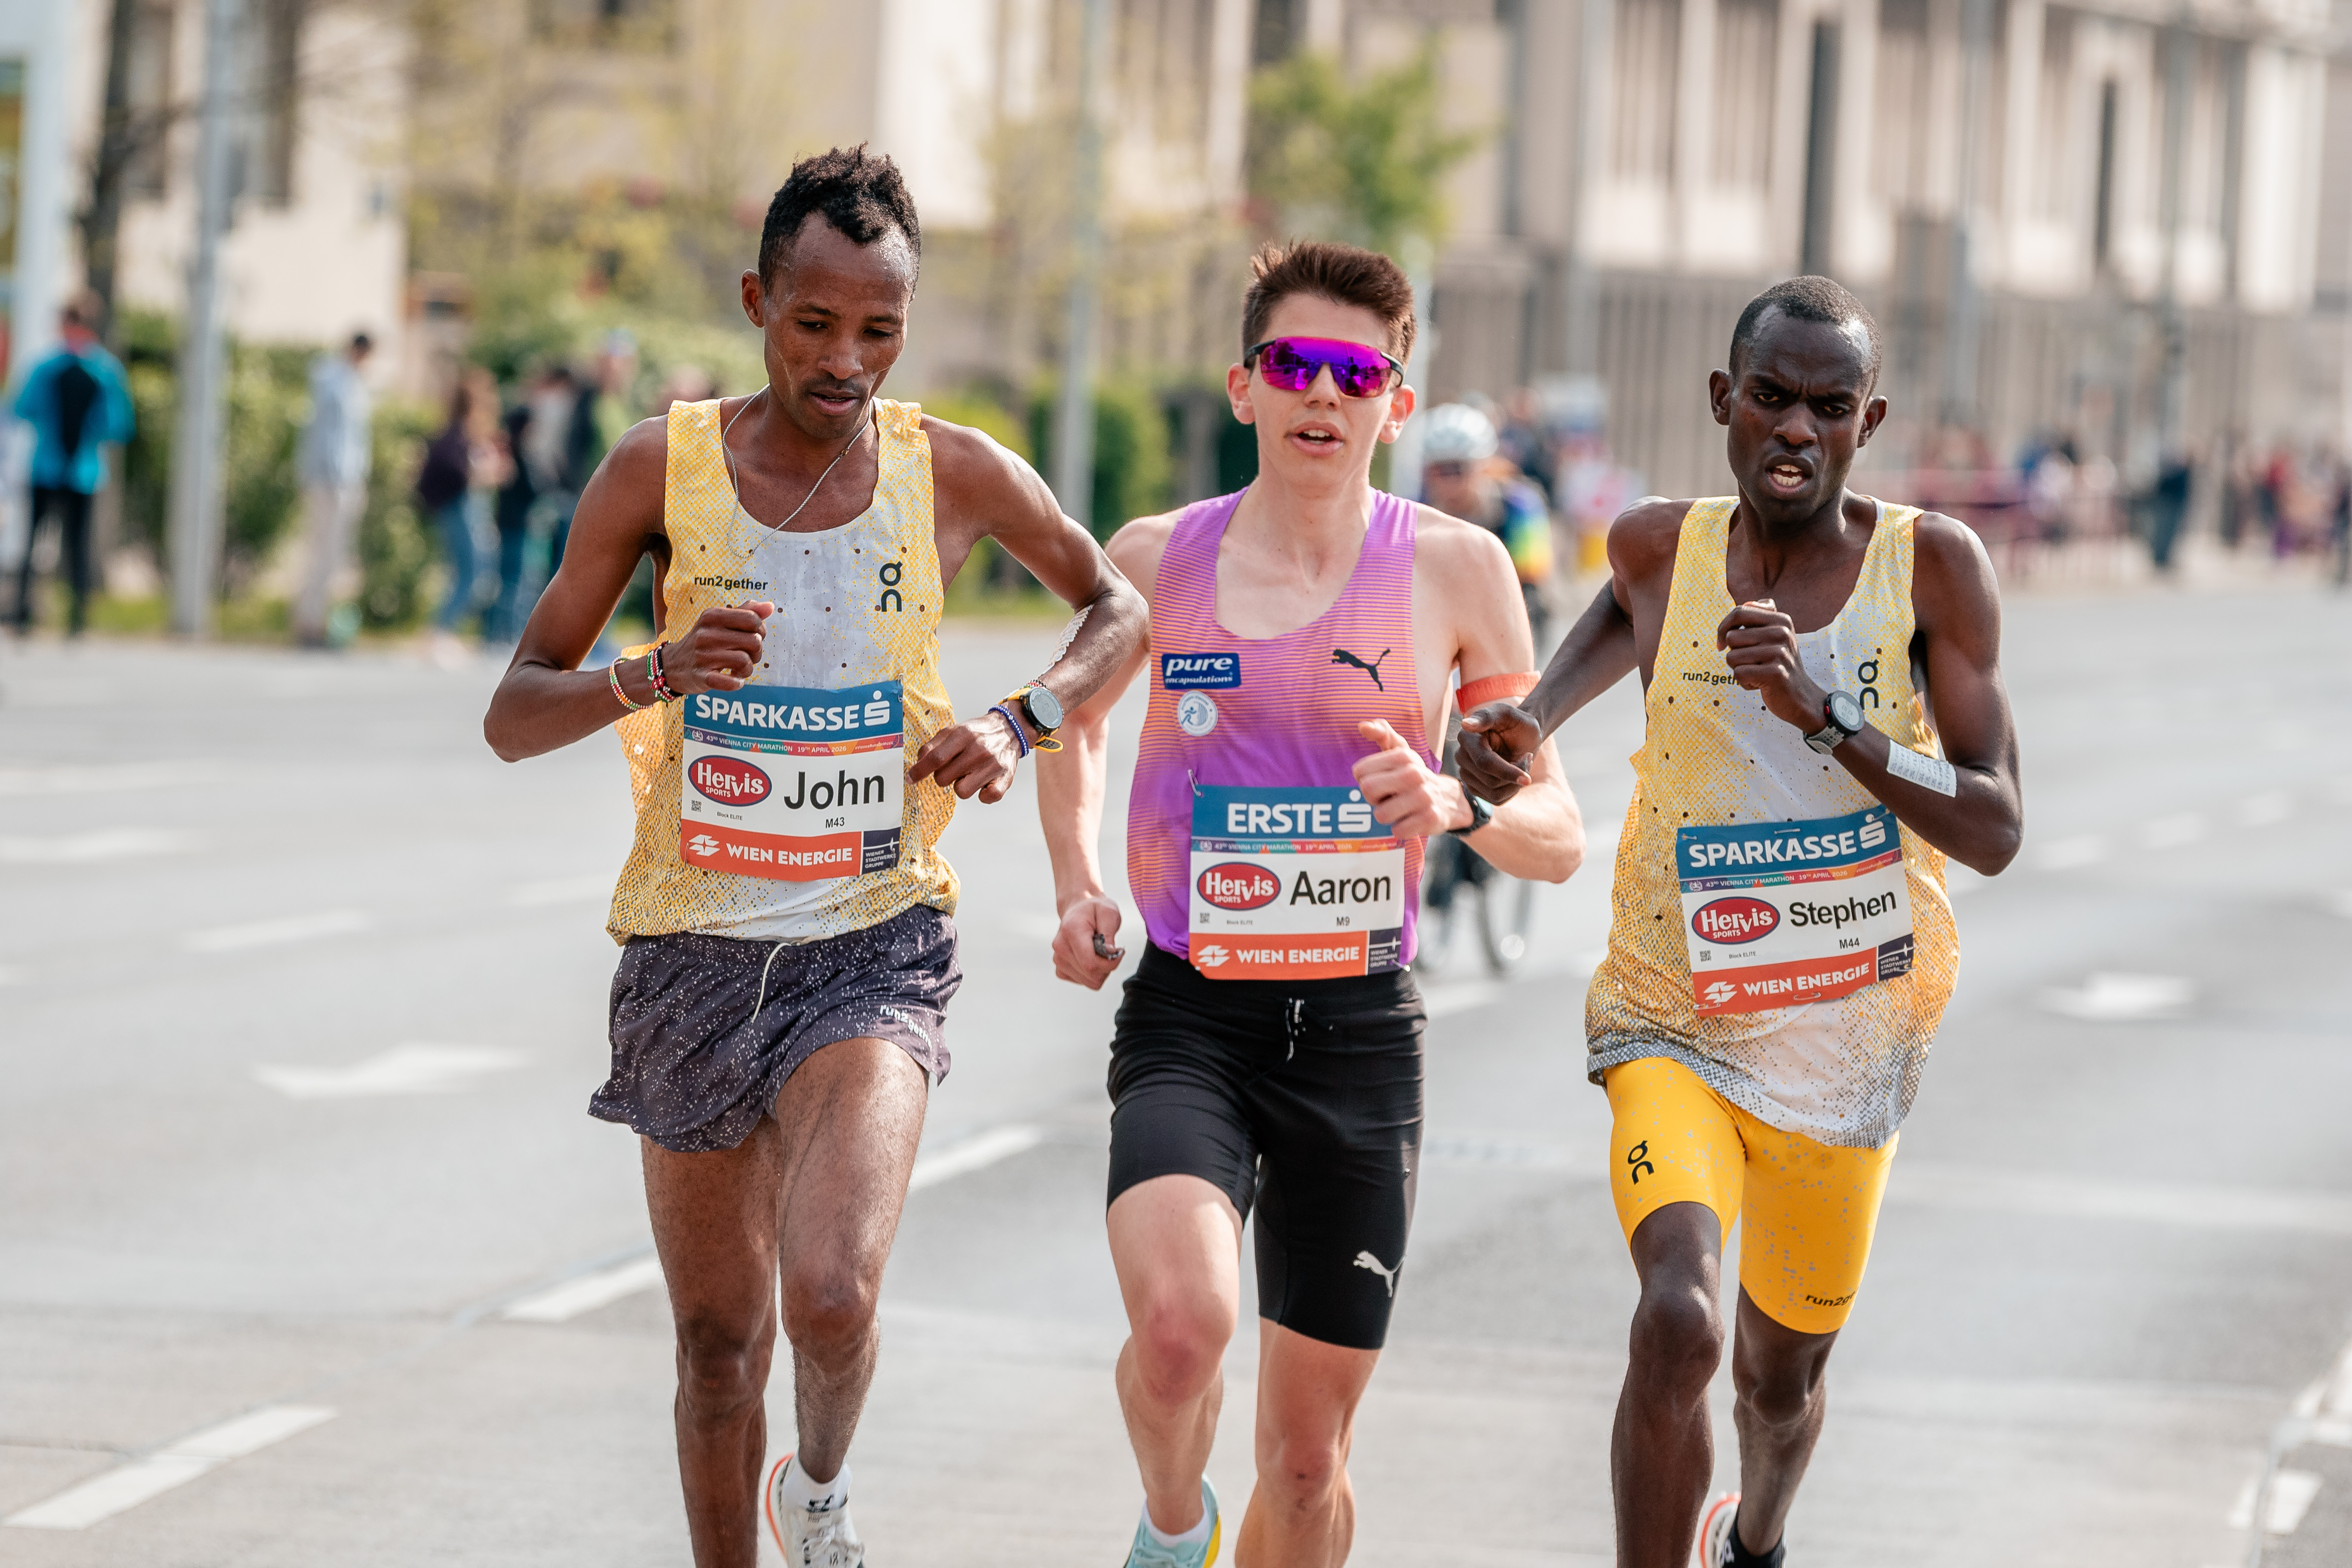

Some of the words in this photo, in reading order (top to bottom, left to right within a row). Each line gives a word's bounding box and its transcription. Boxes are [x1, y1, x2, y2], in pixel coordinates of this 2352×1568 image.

[694, 576, 768, 590] run2gether
[1165, 658, 1233, 677] pure
[695, 694, 860, 731] SPARKASSE
[719, 738, 741, 747] VIENNA
[698, 762, 764, 797] Hervis
[706, 787, 731, 798] SPORTS
[784, 770, 885, 810] John
[825, 818, 845, 829] M43
[1228, 803, 1332, 834] ERSTE
[726, 843, 773, 863] WIEN
[778, 848, 852, 867] ENERGIE
[1688, 830, 1857, 868] SPARKASSE
[1206, 872, 1274, 901] Hervis
[1289, 871, 1390, 906] Aaron
[1760, 875, 1795, 884] MARATHON
[1789, 891, 1897, 929] Stephen
[1336, 916, 1350, 926] M9
[1701, 908, 1773, 933] Hervis
[1713, 929, 1741, 939] SPORTS
[1840, 938, 1860, 949] M44
[1236, 949, 1284, 964] WIEN
[1288, 946, 1359, 964] ENERGIE
[1880, 956, 1899, 965] WIENER
[1881, 958, 1911, 970] STADTWERKE
[1743, 979, 1792, 996] WIEN
[1797, 962, 1869, 990] ENERGIE
